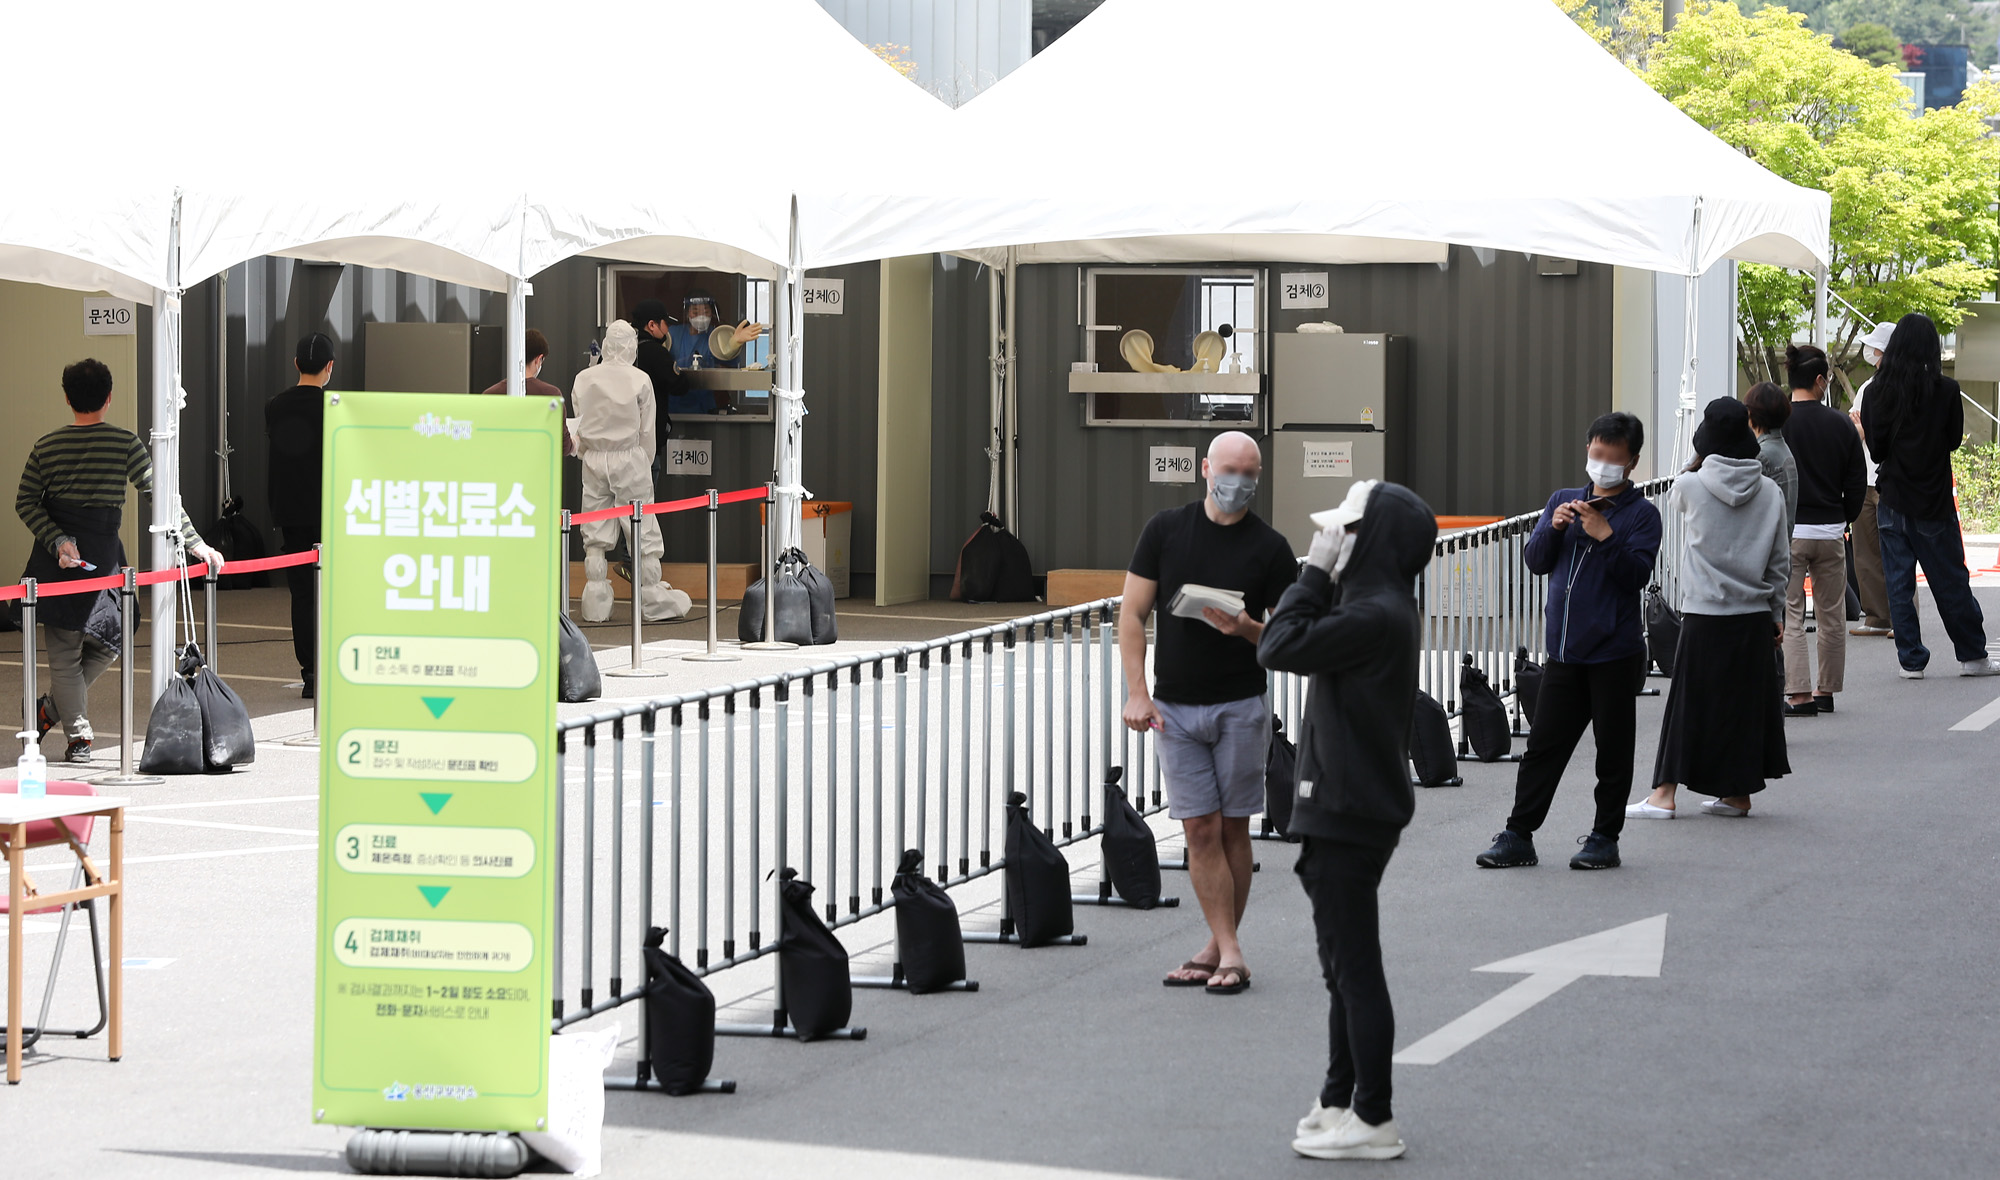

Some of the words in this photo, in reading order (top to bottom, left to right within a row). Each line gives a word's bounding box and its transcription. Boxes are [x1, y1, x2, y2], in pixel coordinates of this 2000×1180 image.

[804, 288, 841, 305] 검체①
[1286, 283, 1325, 299] 검체②
[88, 308, 131, 325] 문진①
[671, 450, 709, 466] 검체①
[1154, 457, 1193, 473] 검체②
[343, 479, 536, 538] 선별진료소
[383, 553, 491, 612] 안내
[351, 648, 359, 671] 1
[375, 646, 400, 660] 안내
[375, 663, 386, 675] 손
[411, 664, 422, 676] 후
[424, 664, 454, 677] 문진표
[348, 741, 361, 764] 2
[373, 739, 399, 754] 문진
[346, 836, 360, 859] 3
[372, 835, 397, 849] 진료
[344, 930, 359, 954] 4
[370, 929, 421, 944] 검체채취
[426, 985, 458, 1000] 1~2일
[462, 986, 483, 1001] 정도
[467, 1006, 490, 1021] 안내
